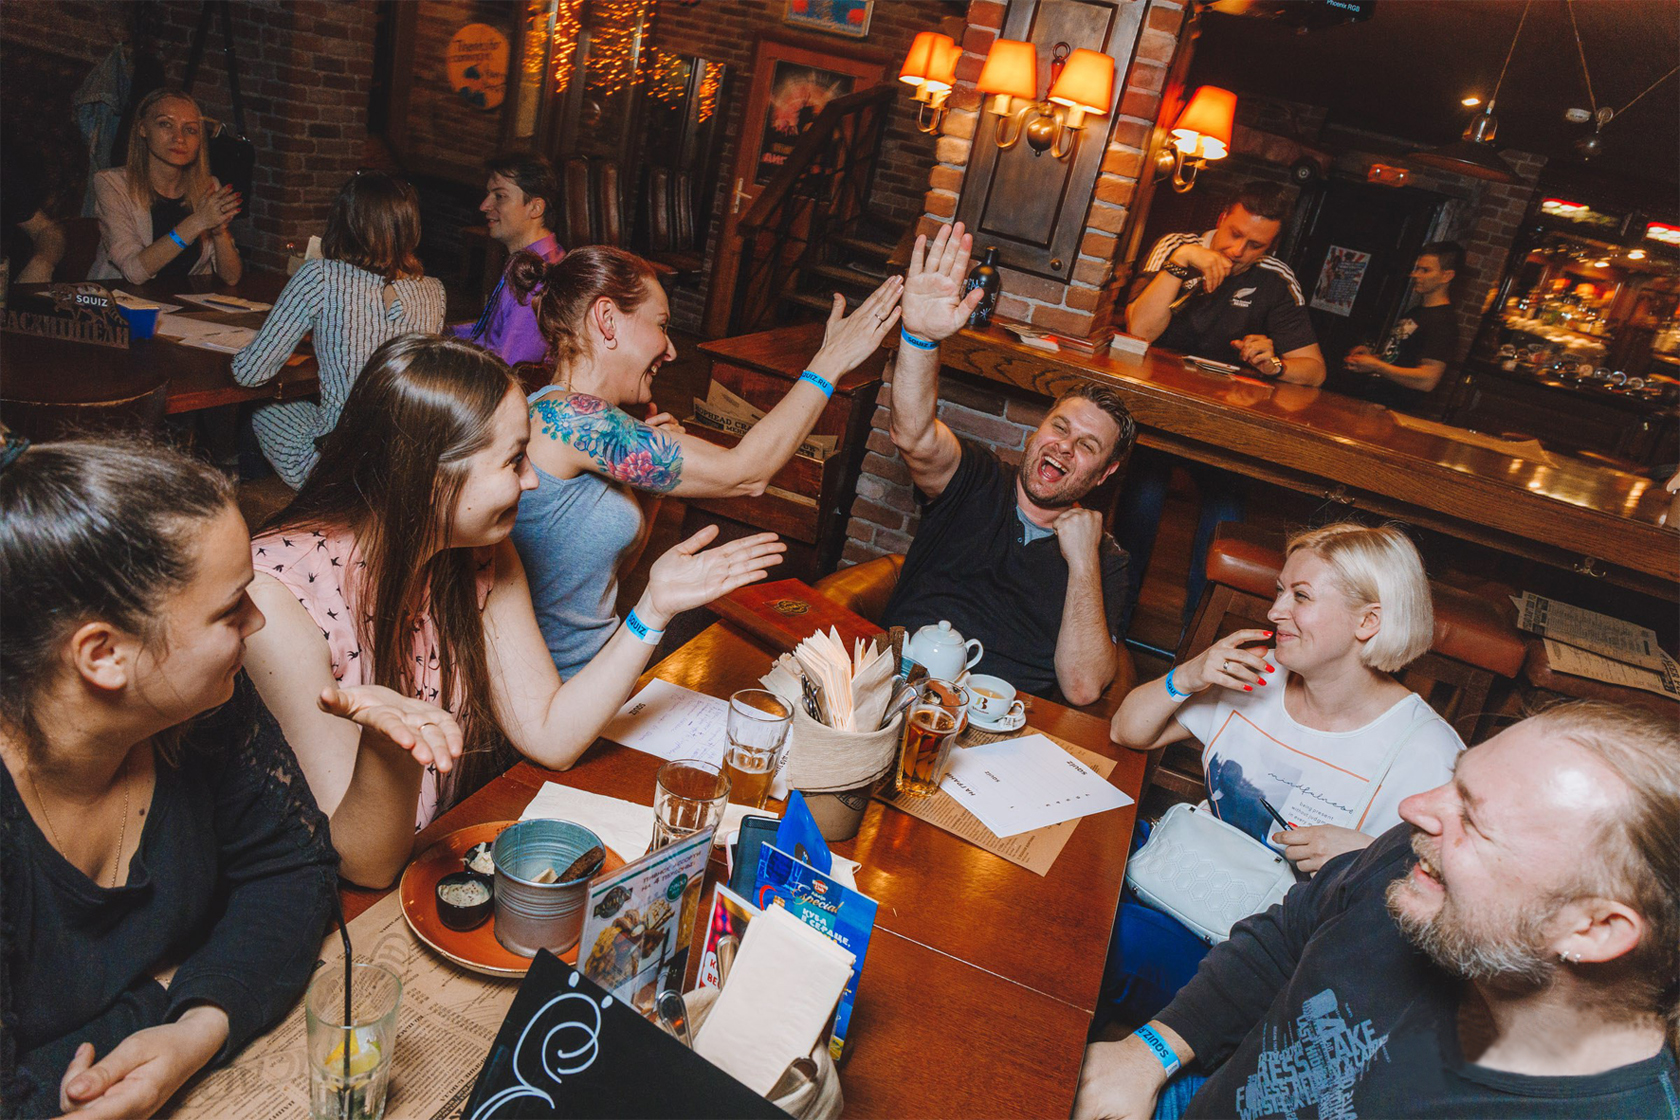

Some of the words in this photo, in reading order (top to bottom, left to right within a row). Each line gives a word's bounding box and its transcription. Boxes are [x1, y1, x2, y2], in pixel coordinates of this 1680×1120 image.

[1327, 0, 1347, 9] Phoenix
[1347, 4, 1360, 12] RGB
[76, 295, 108, 307] SQUIZ
[628, 702, 646, 716] SQUIZ
[1066, 760, 1088, 776] SQUIZ
[1267, 772, 1354, 814] mindfulness
[1291, 806, 1309, 818] without
[1295, 814, 1308, 825] every
[1299, 802, 1314, 814] being
[1312, 807, 1335, 821] present
[790, 881, 845, 914] Especial
[802, 908, 827, 925] КУБА
[808, 918, 851, 948] СЕРДЦЕ,
